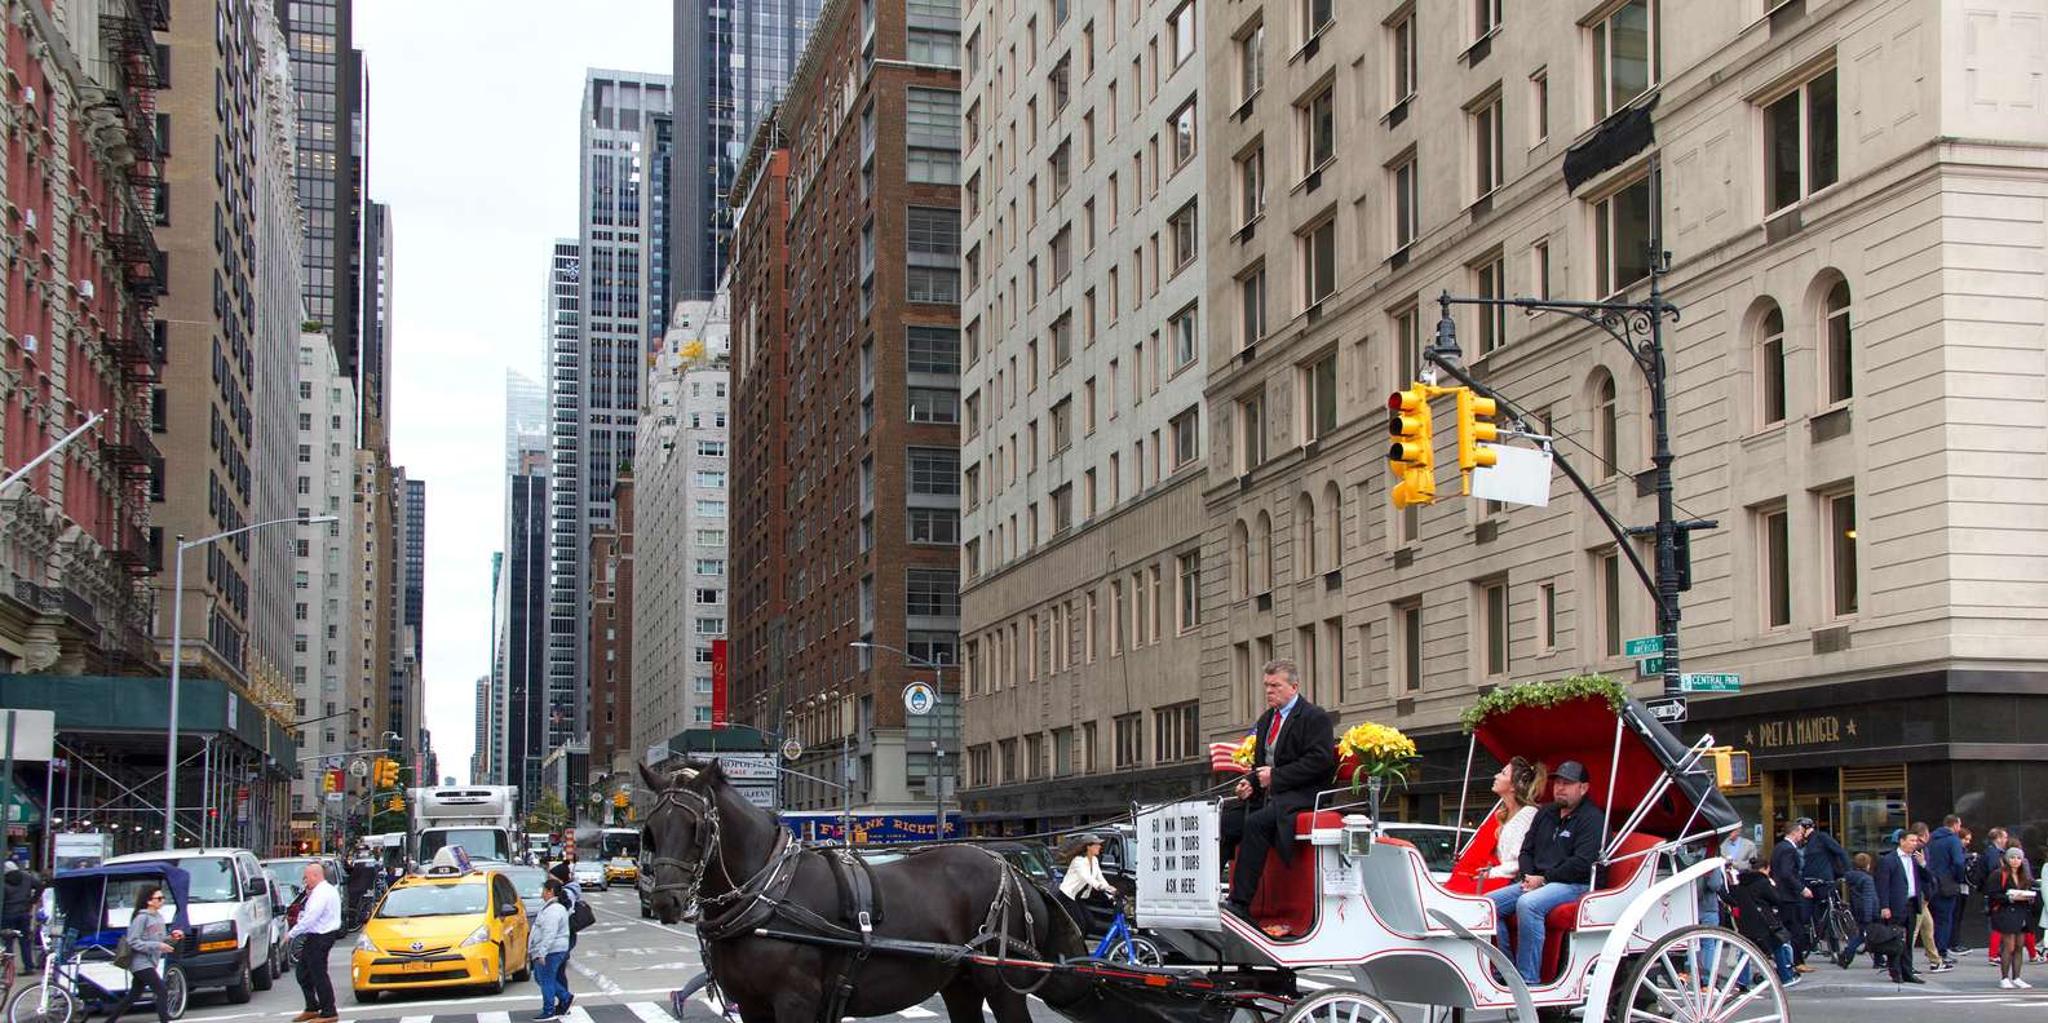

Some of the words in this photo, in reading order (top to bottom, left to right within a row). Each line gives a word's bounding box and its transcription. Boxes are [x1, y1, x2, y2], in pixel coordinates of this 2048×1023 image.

[1692, 674, 1722, 685] CENTRAL
[1724, 676, 1739, 686] PARK
[1760, 722, 1784, 747] PRET
[1786, 720, 1794, 745] A
[1796, 716, 1840, 745] MANGER
[893, 819, 956, 835] RICHTR
[1152, 818, 1159, 833] 60
[1165, 817, 1175, 832] MIN
[1181, 816, 1199, 832] TOURS
[1153, 837, 1160, 852] 40
[1165, 837, 1176, 851] MIN
[1181, 835, 1200, 851] TOURS
[1153, 856, 1160, 871] 20
[1165, 855, 1176, 871] MIN
[1182, 854, 1200, 871] TOURS
[1166, 878, 1177, 893] ASK
[1181, 878, 1195, 893] HERE
